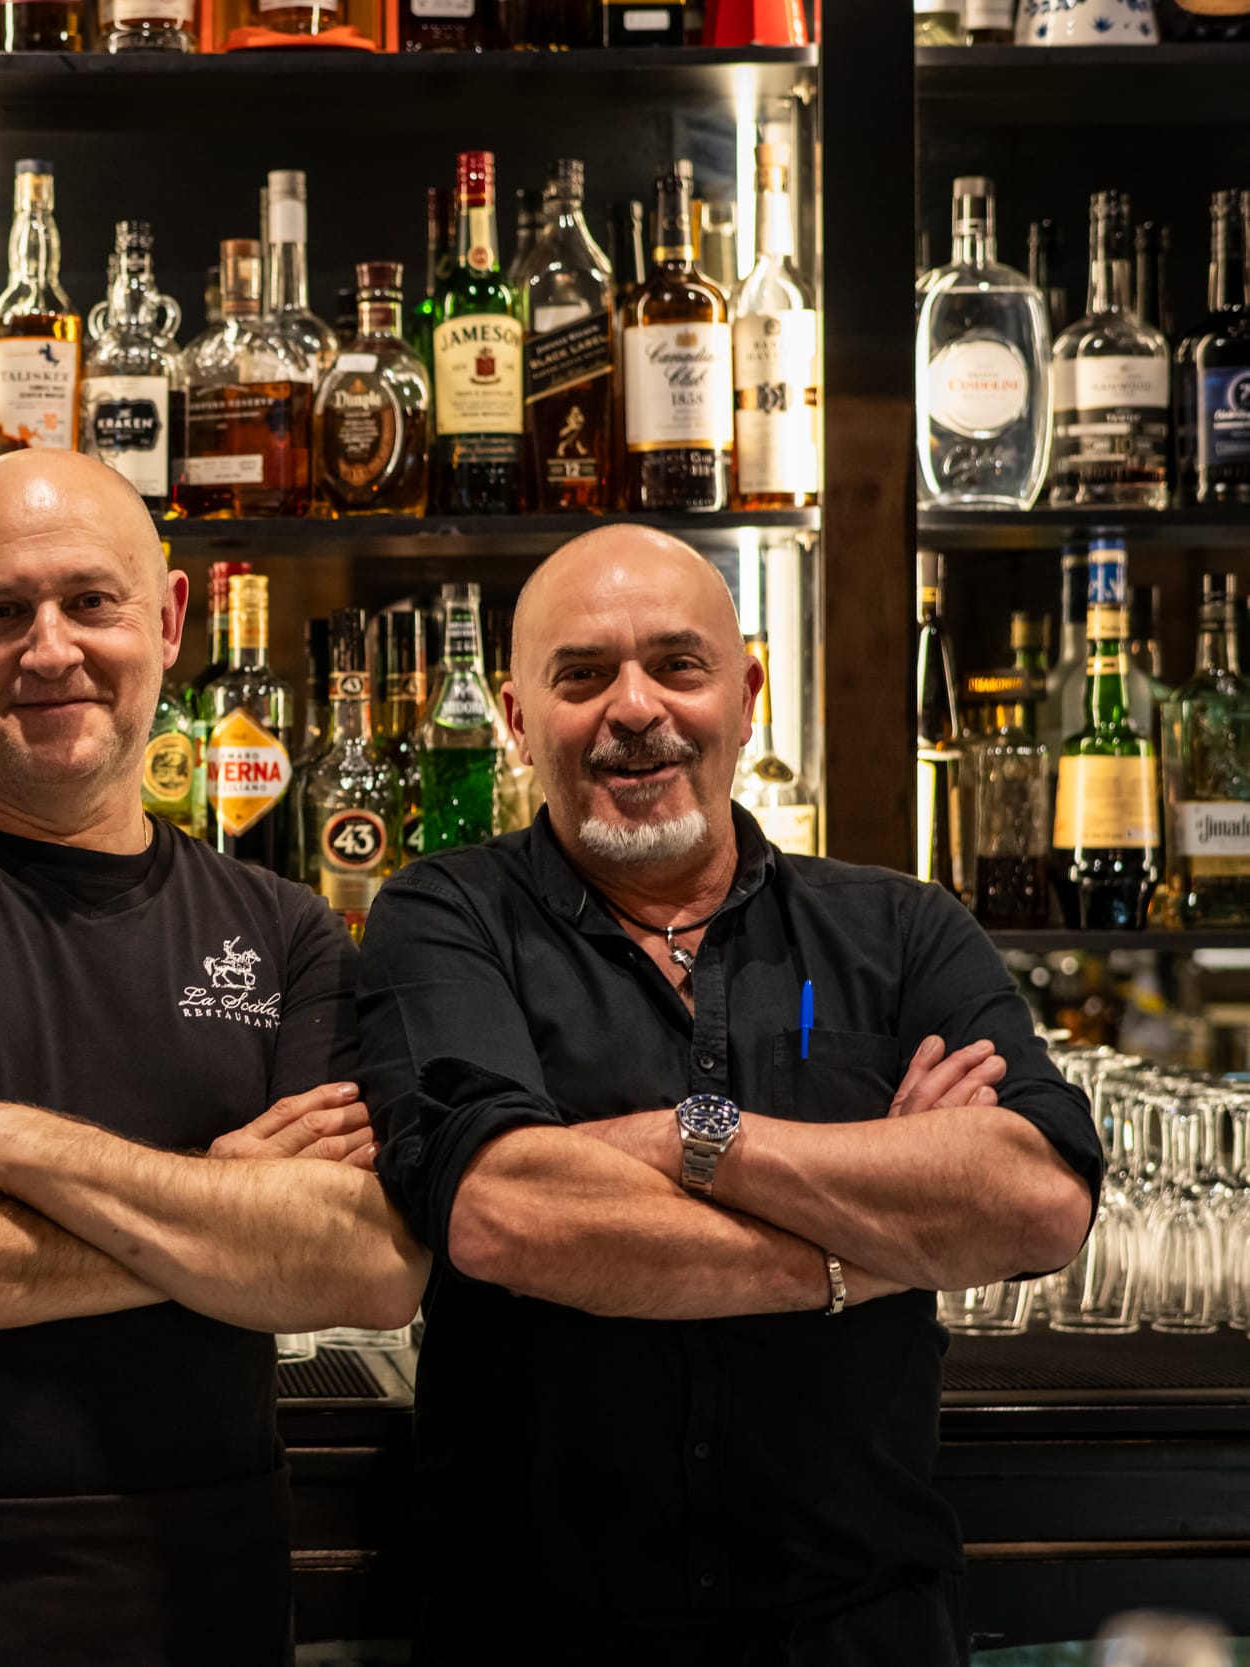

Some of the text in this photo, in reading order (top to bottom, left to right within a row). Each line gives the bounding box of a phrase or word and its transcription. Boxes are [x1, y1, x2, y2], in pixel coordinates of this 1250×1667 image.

[440, 325, 521, 352] JAMESON
[530, 348, 568, 369] BLACK
[1, 371, 70, 382] TALISKER
[664, 365, 707, 386] Club
[334, 390, 382, 410] Dimple
[97, 418, 153, 429] KRAKEN
[208, 762, 282, 781] AVERNA
[333, 824, 374, 854] 43
[178, 986, 281, 1019] La Scala
